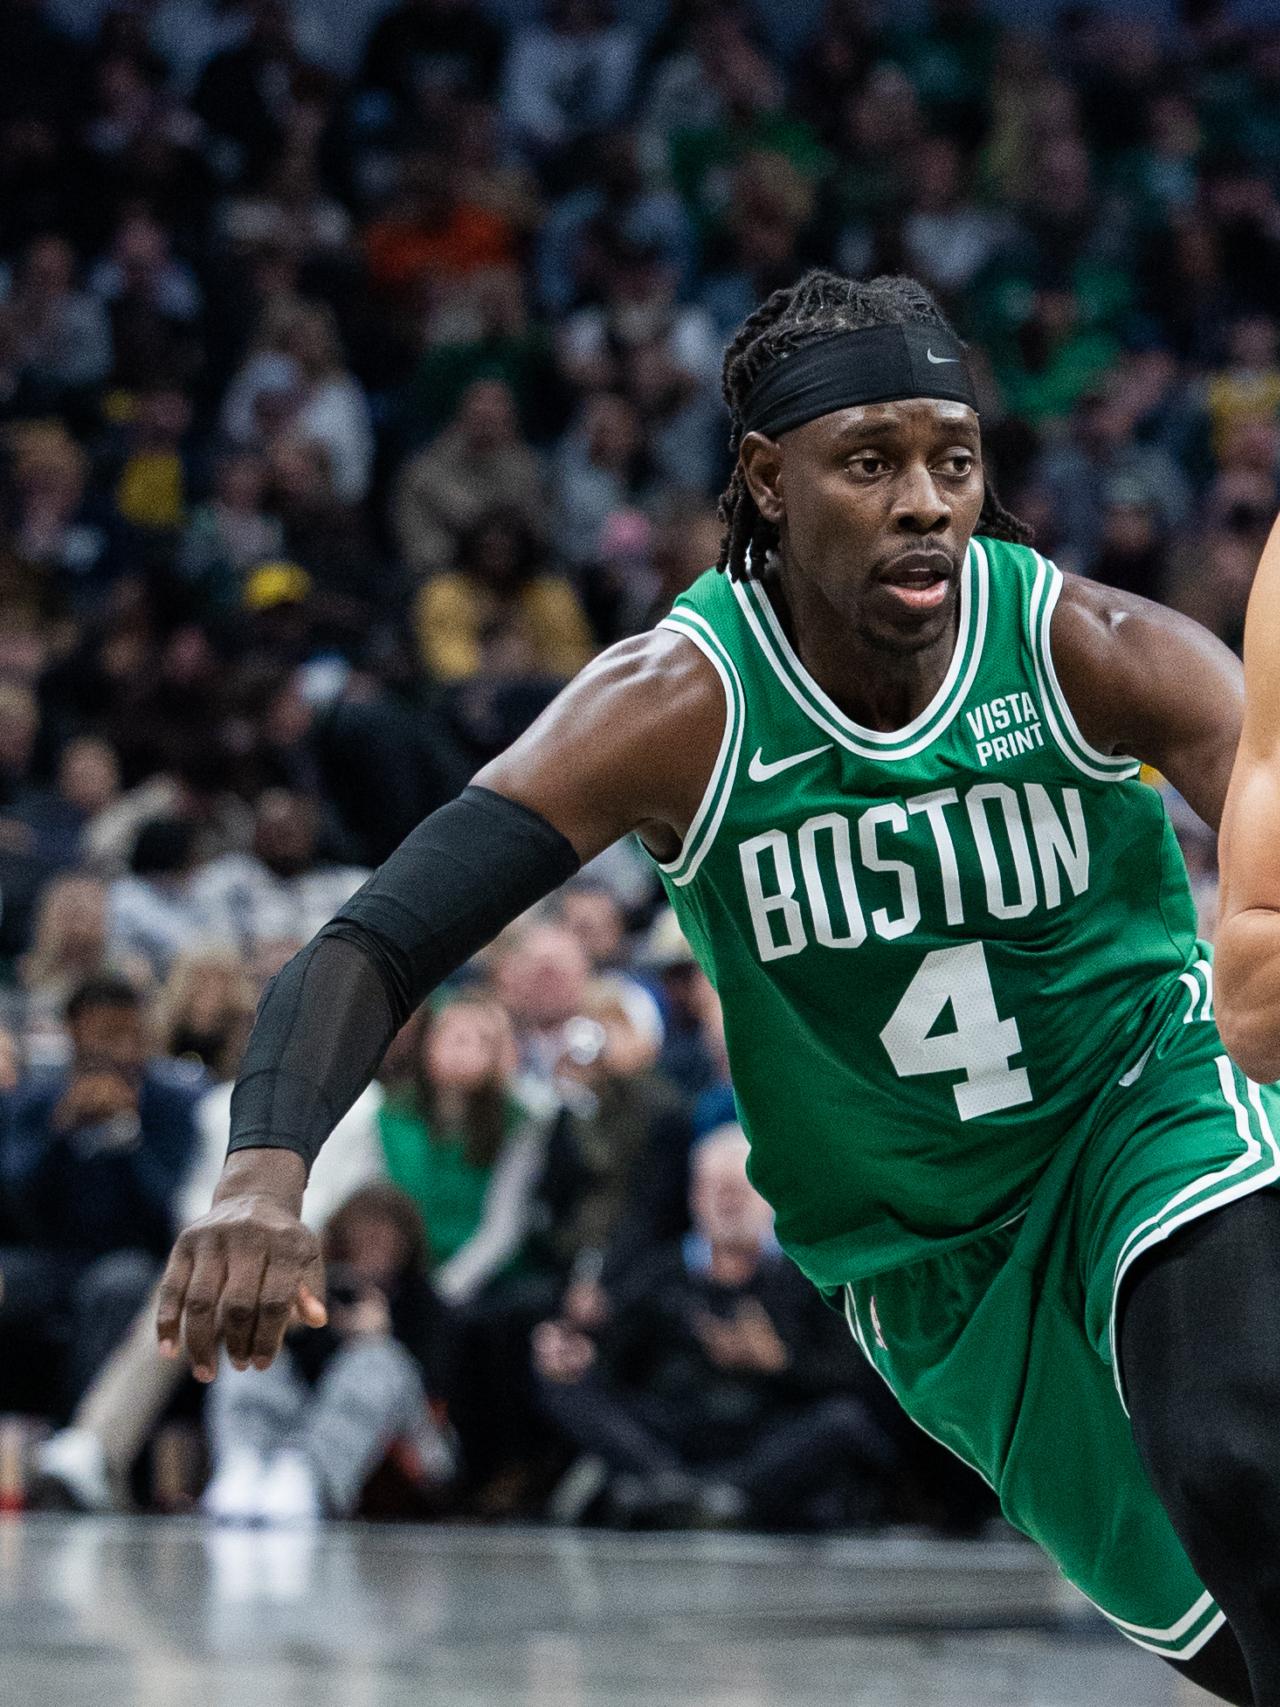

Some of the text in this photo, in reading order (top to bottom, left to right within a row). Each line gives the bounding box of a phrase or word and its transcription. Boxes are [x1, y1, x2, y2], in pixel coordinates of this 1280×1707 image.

[966, 691, 1039, 741] VISTA
[975, 721, 1045, 767] PRINT
[738, 782, 1090, 962] BOSTON
[879, 941, 1033, 1122] 4
